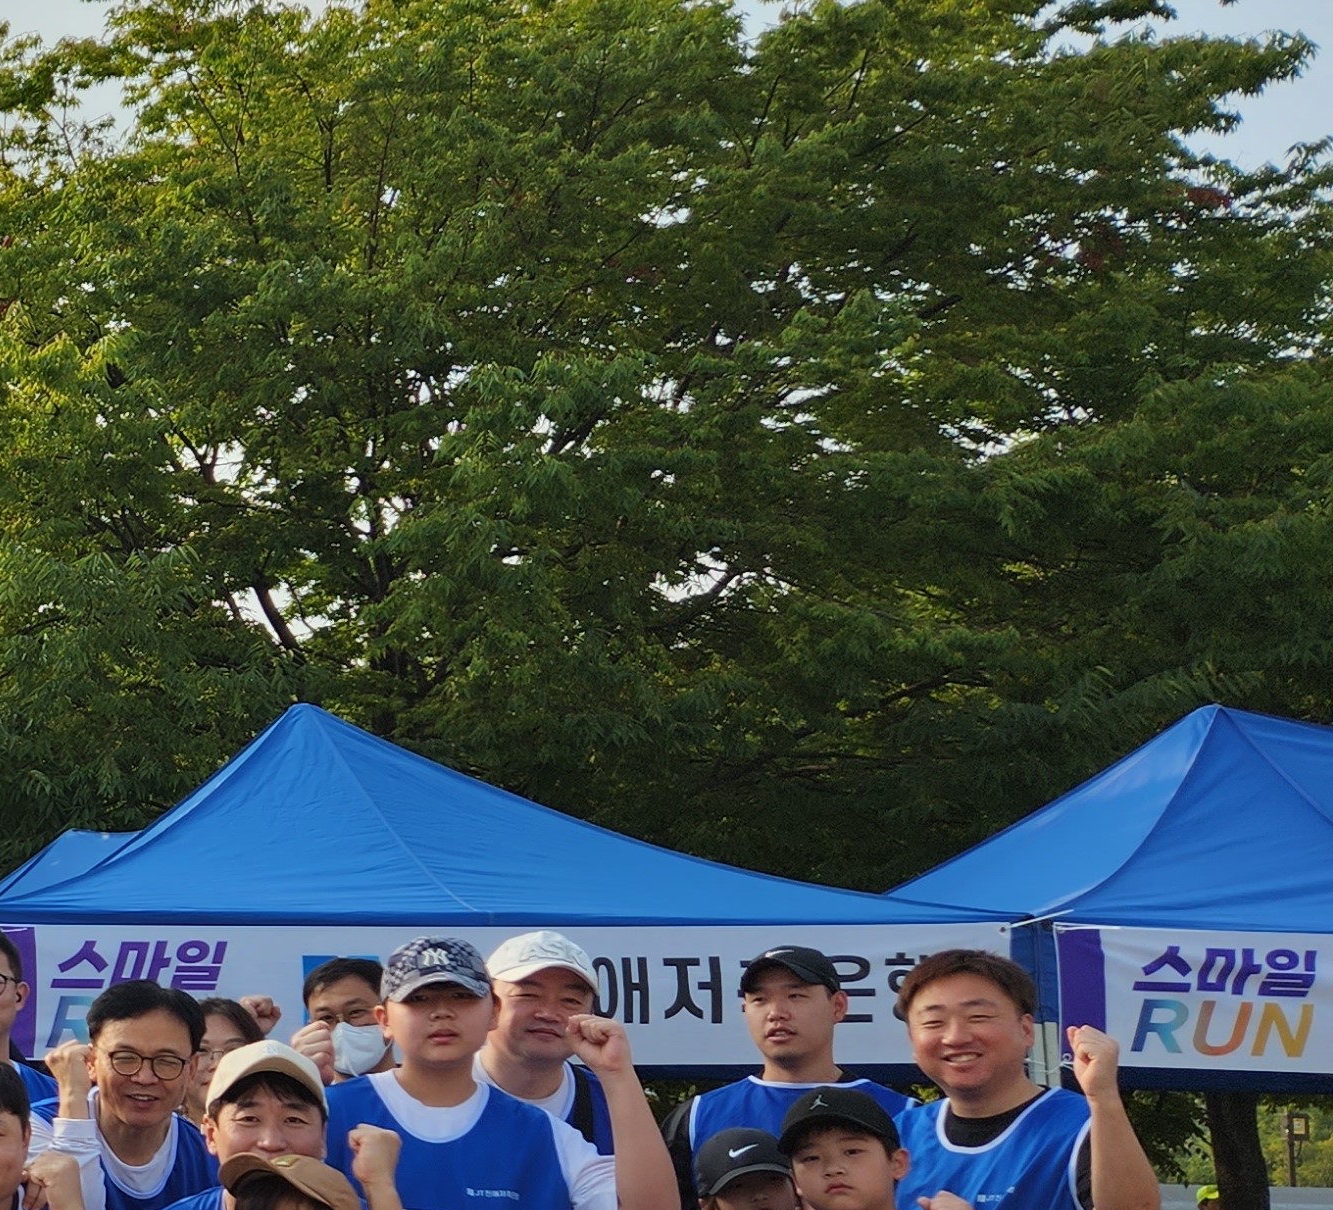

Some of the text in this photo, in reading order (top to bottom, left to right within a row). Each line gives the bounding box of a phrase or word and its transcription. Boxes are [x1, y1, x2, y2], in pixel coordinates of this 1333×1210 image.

[50, 940, 228, 991] 스마일
[1132, 946, 1317, 997] 스마일
[1130, 999, 1314, 1058] RUN
